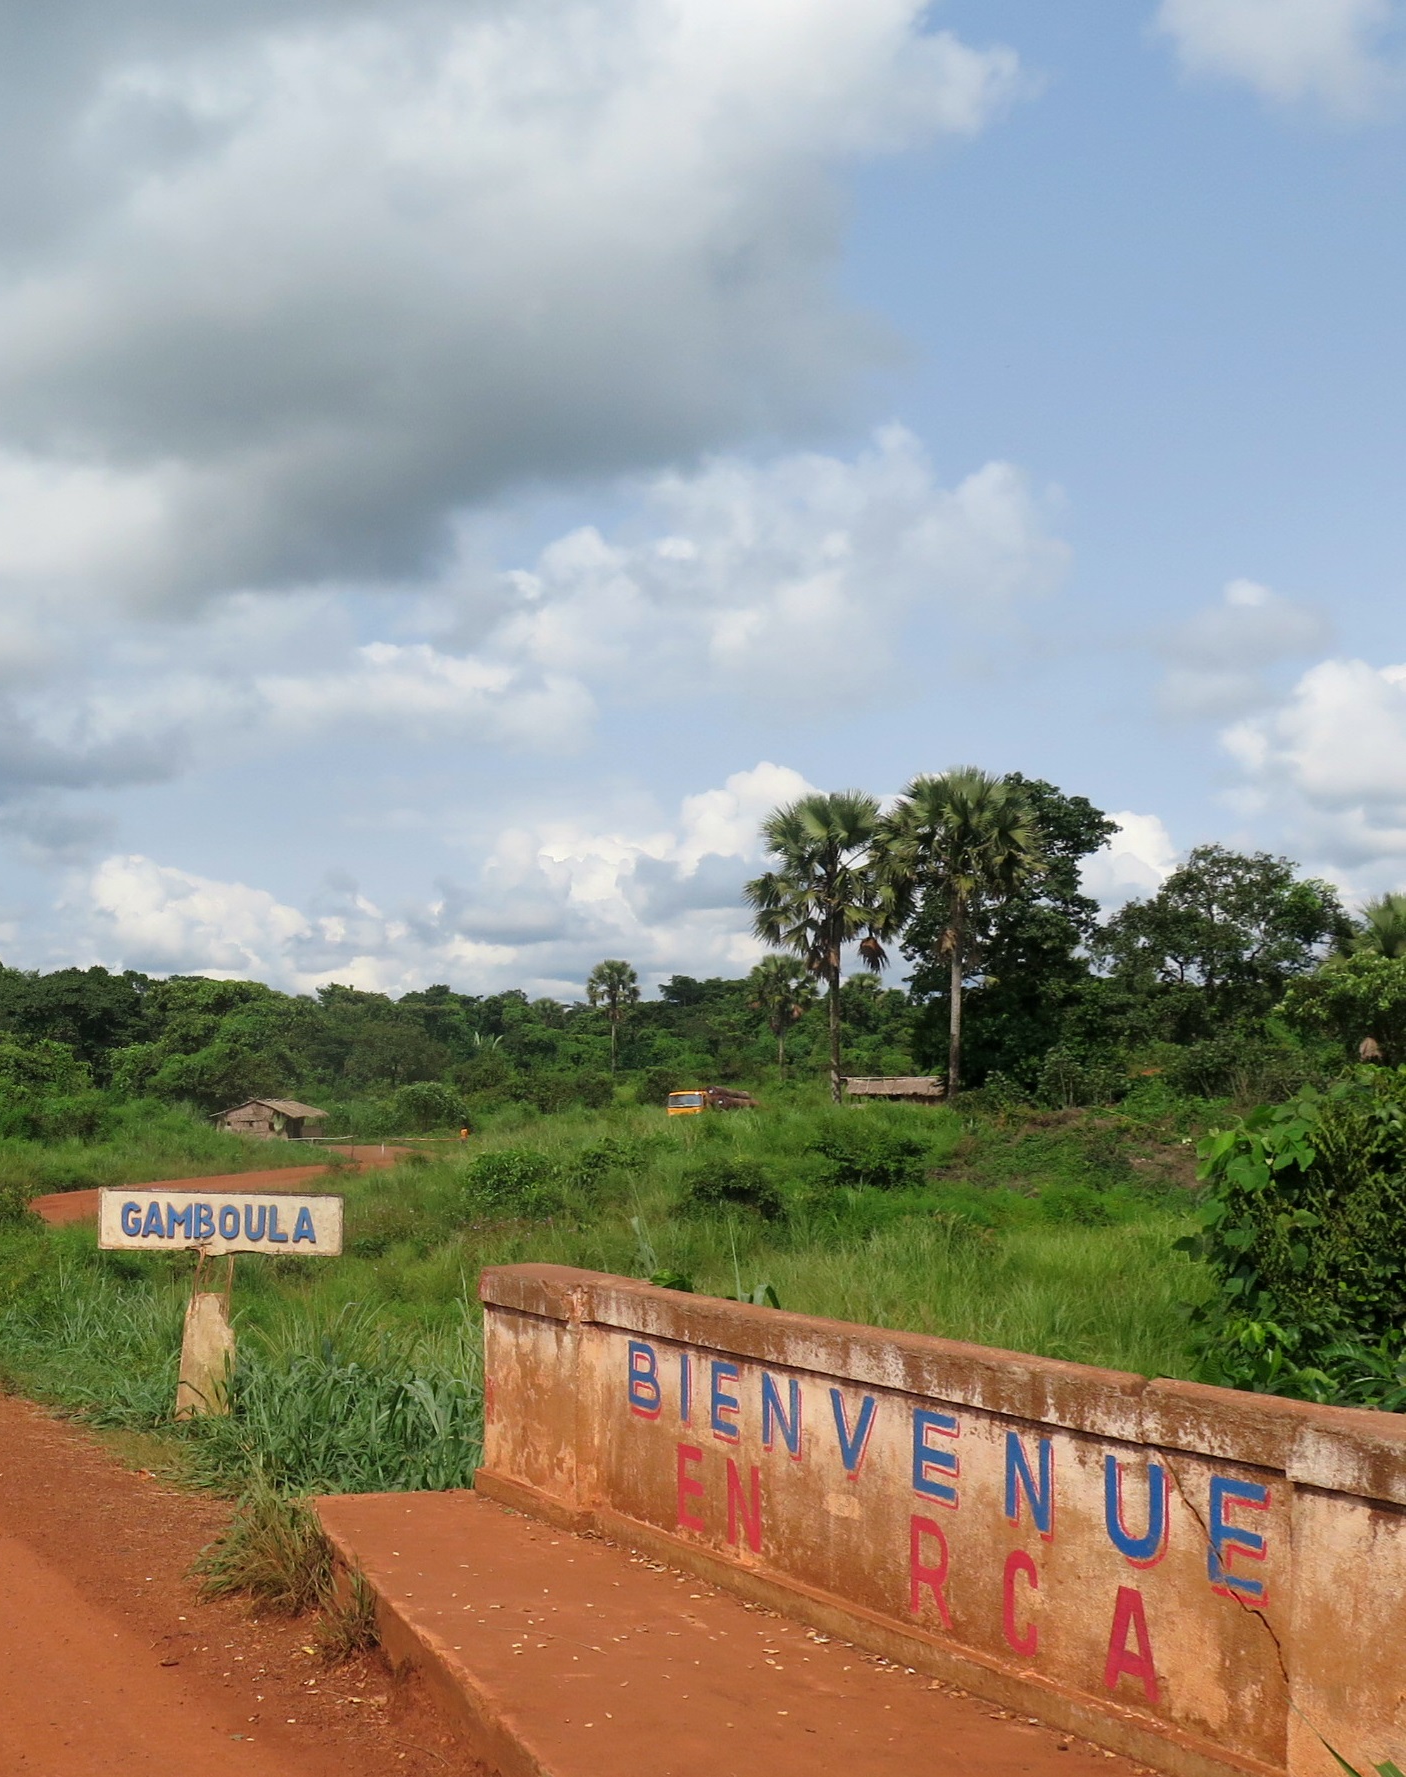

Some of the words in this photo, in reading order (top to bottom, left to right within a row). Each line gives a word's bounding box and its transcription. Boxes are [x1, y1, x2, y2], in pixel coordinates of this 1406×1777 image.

[121, 1201, 316, 1243] GAMBOULA
[628, 1340, 1271, 1607] BIENVENUE
[676, 1443, 762, 1554] EN
[909, 1515, 1160, 1704] RCA
